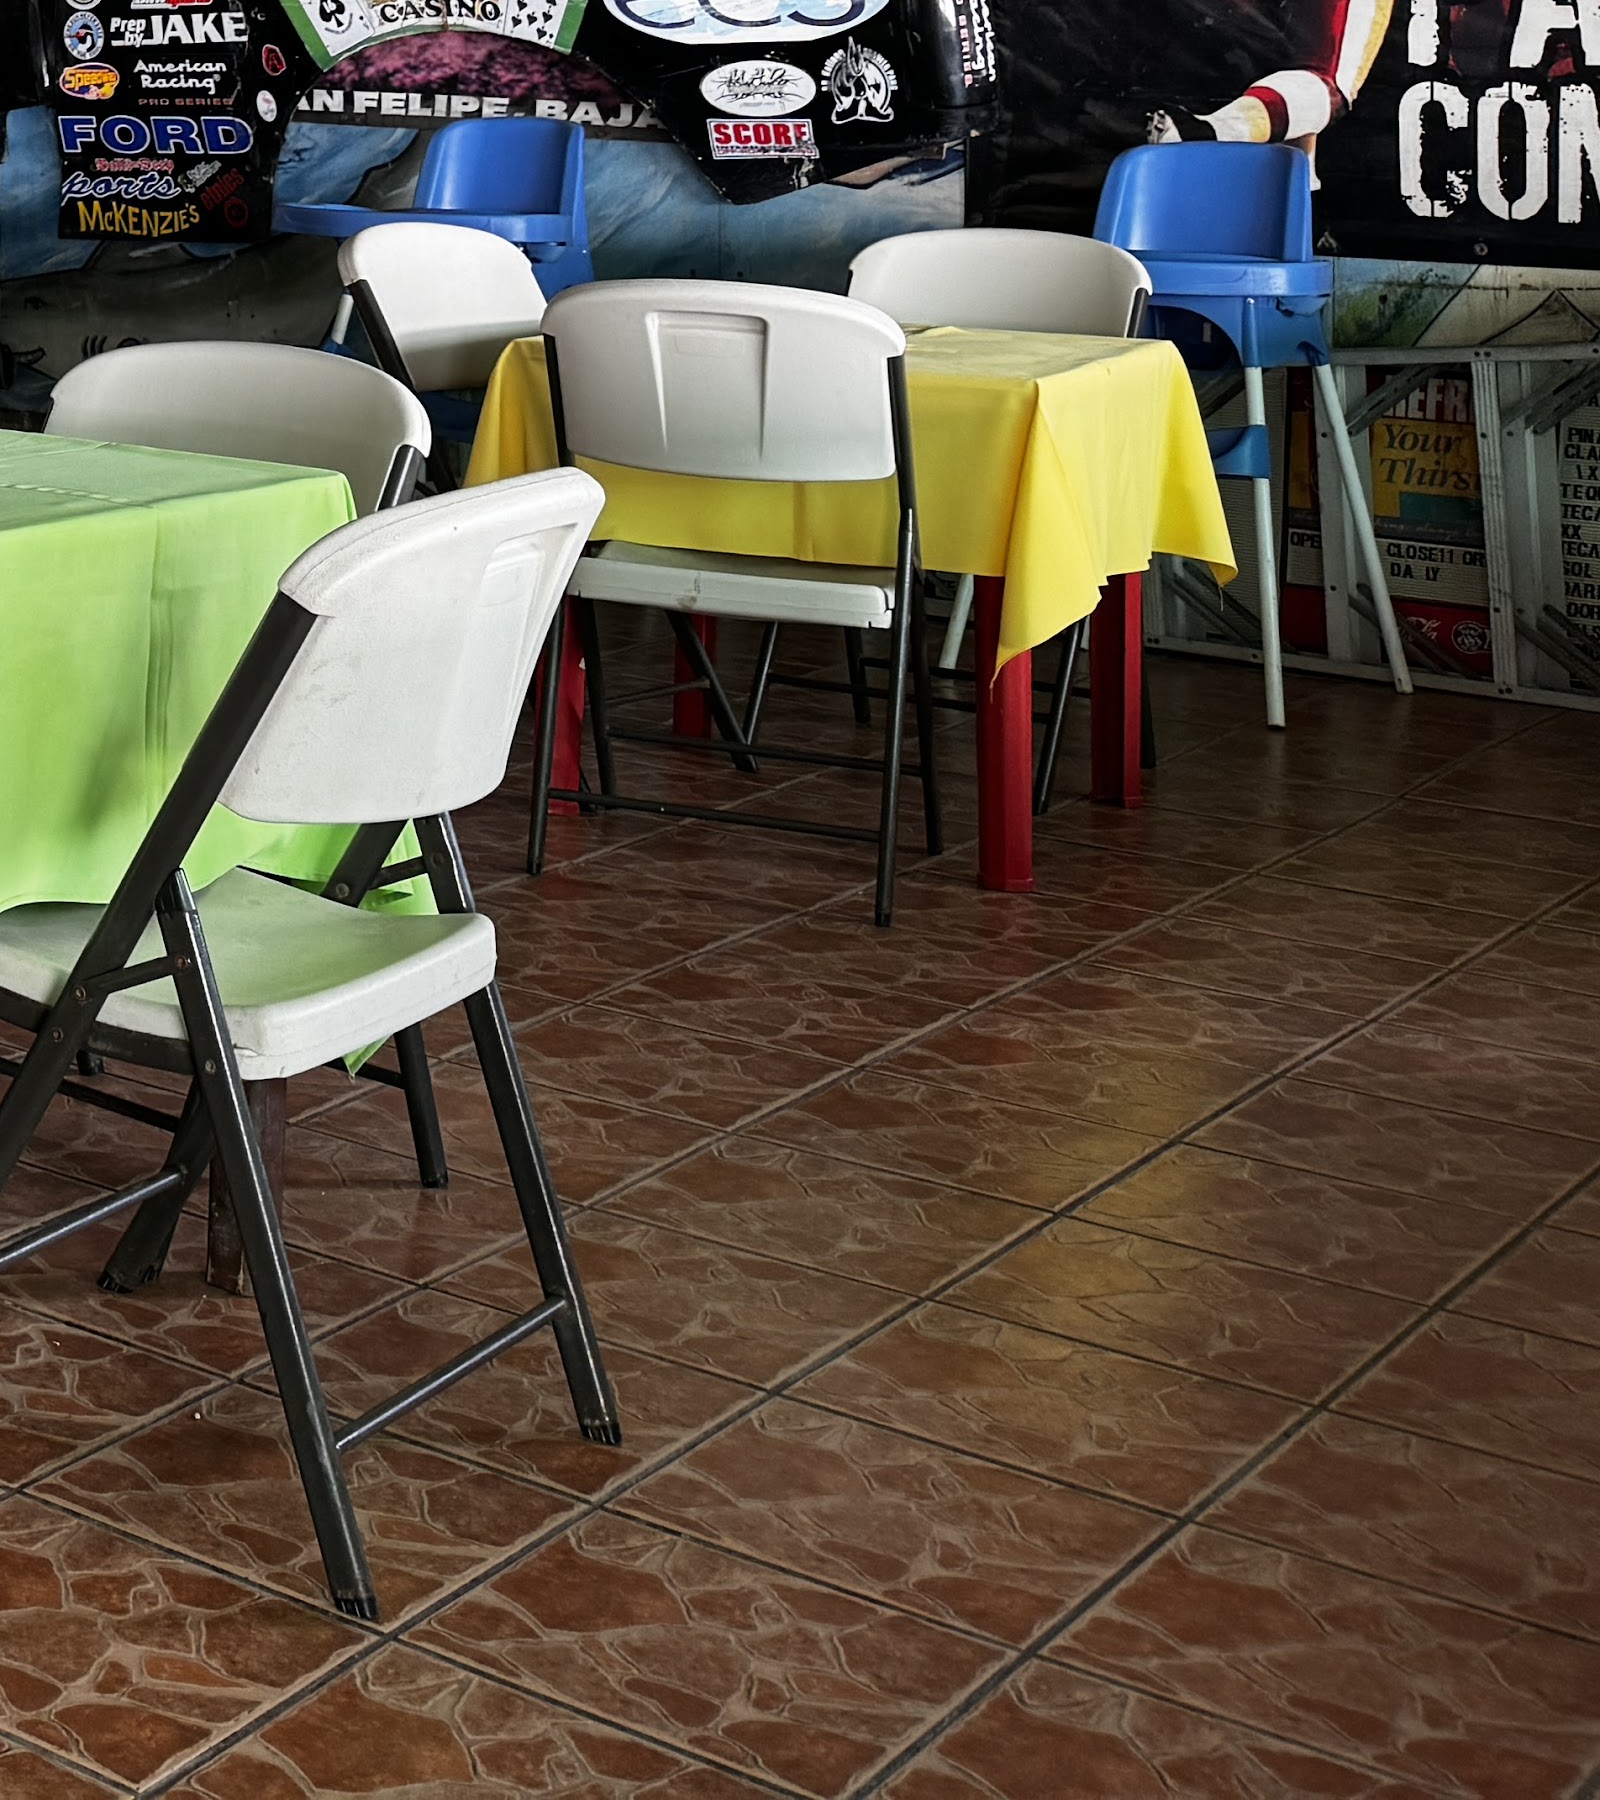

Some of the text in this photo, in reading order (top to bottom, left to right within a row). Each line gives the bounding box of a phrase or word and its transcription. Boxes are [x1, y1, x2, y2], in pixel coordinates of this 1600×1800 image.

[380, 0, 502, 24] CASINO
[110, 17, 146, 34] Prep
[125, 12, 249, 48] by JAKE
[134, 59, 227, 73] American
[138, 98, 233, 106] PRO SERIES
[58, 115, 254, 154] FORD
[713, 121, 809, 146] SCORE
[1383, 423, 1460, 454] Your
